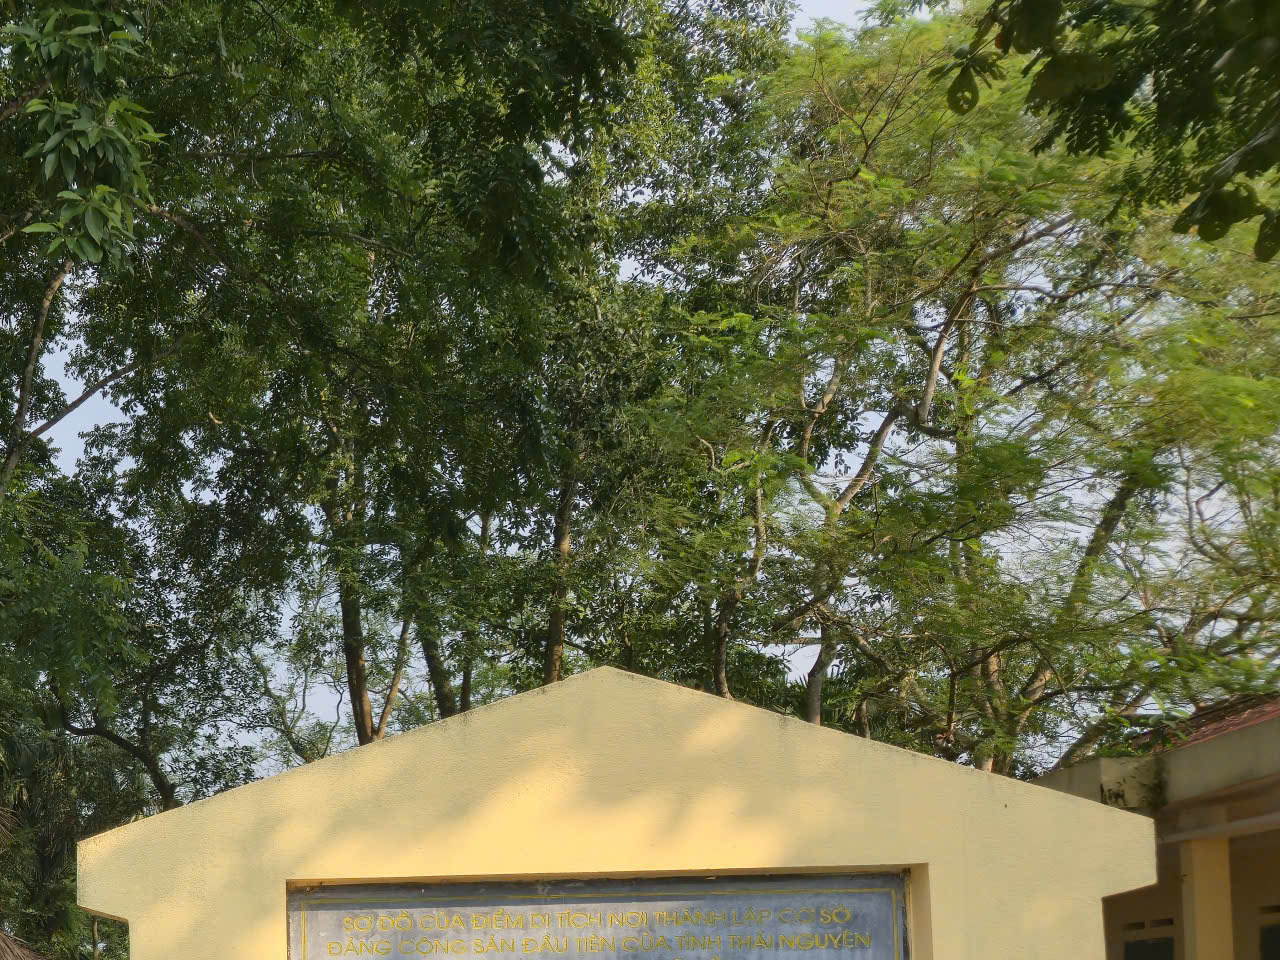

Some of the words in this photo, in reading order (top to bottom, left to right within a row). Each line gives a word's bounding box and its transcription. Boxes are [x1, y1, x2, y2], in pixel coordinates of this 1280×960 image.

[343, 914, 372, 932] SƠ
[378, 909, 413, 931] ĐỒ
[418, 911, 464, 930] CỦA
[471, 908, 524, 930] ĐIỂM
[529, 912, 550, 928] DI
[556, 908, 602, 928] TÍCH
[608, 911, 648, 928] NƠI
[655, 907, 726, 927] THÀNH
[327, 936, 393, 956] ĐẢNG
[397, 936, 467, 956] CỘNG
[472, 934, 516, 954] SẢN
[521, 932, 569, 953] ĐẦU
[575, 933, 616, 953] TIÊN
[621, 931, 670, 952] CỦA
[778, 929, 872, 950] NGUYÊN
